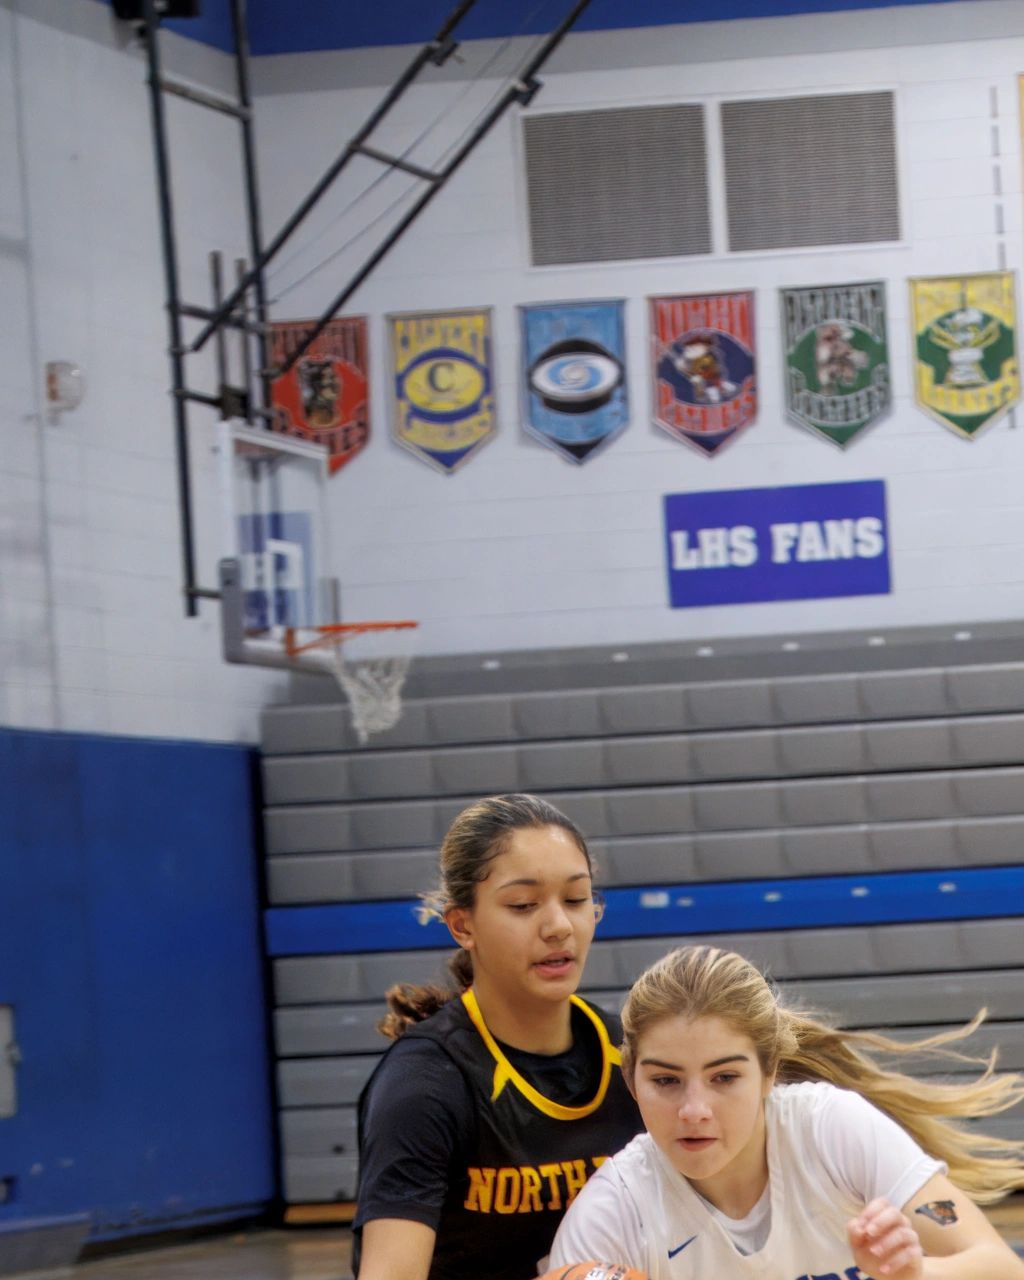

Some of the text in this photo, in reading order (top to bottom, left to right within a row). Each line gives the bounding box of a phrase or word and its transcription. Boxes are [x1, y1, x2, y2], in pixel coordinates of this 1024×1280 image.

[427, 361, 456, 393] C
[669, 516, 885, 571] LHS FANS
[463, 1155, 613, 1214] NORTH
